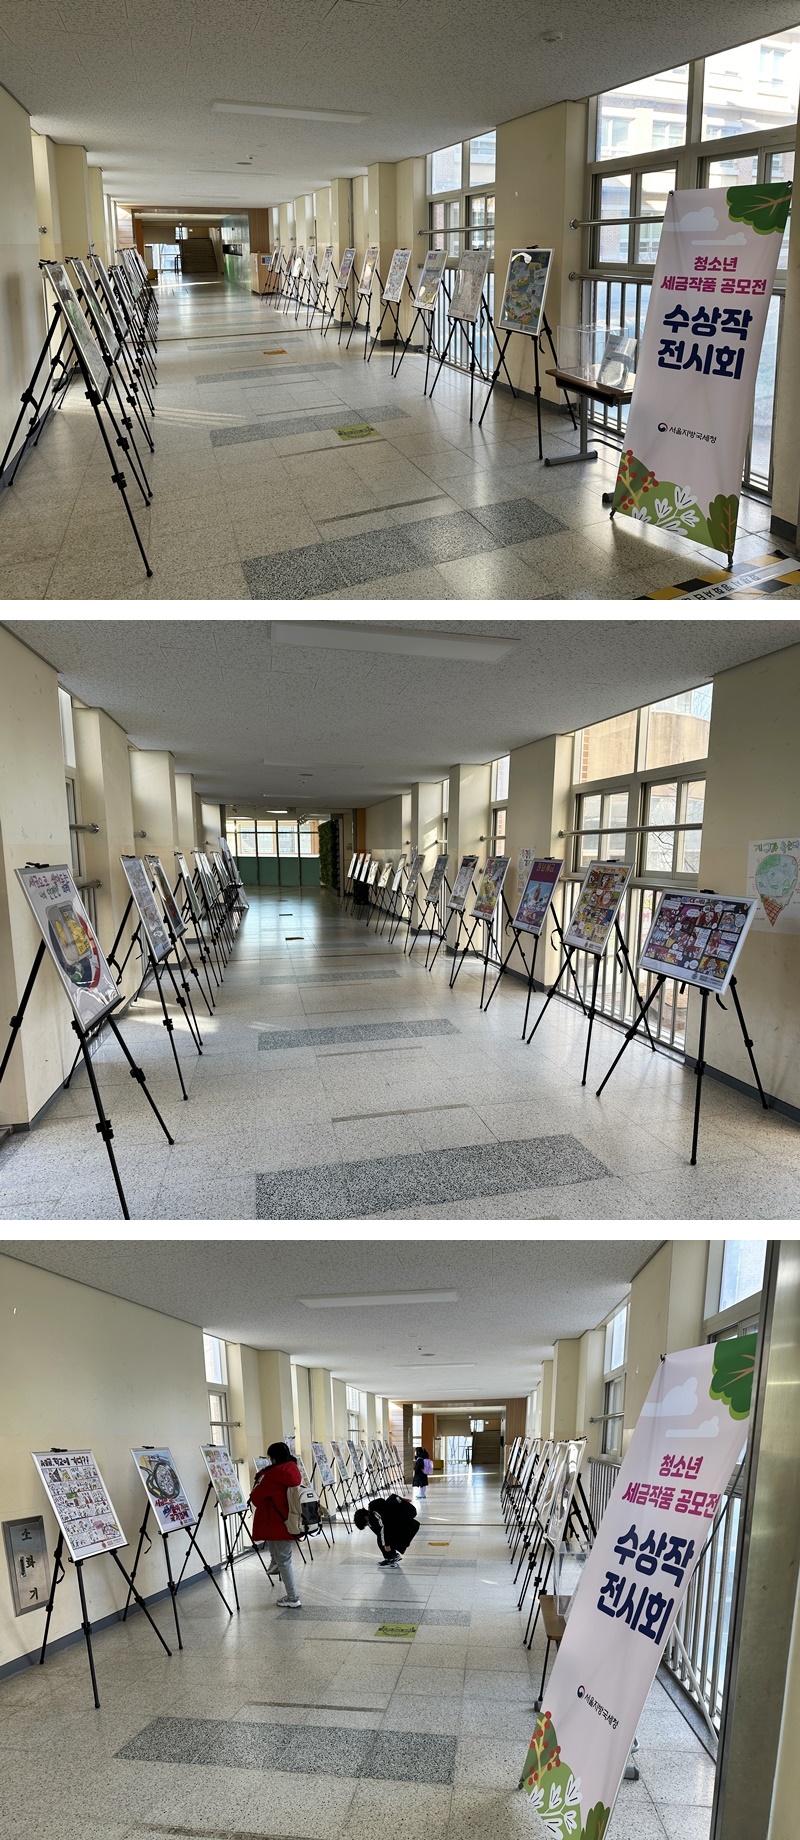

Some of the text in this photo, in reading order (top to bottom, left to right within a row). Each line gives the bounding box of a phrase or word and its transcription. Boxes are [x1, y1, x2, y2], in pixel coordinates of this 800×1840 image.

[694, 256, 738, 272] 청소년
[660, 276, 768, 295] 세금작품 공모전
[662, 304, 754, 341] 수상작
[657, 339, 745, 380] 전시회
[669, 426, 718, 444] 서울지방국세청
[659, 1454, 703, 1480] 청소년
[622, 1481, 720, 1518] 세금작품 공모전
[21, 1528, 39, 1600] 소화기
[613, 1523, 695, 1588] 수상작
[596, 1571, 675, 1646] 전시회
[584, 1693, 620, 1730] 서울지방국세청
